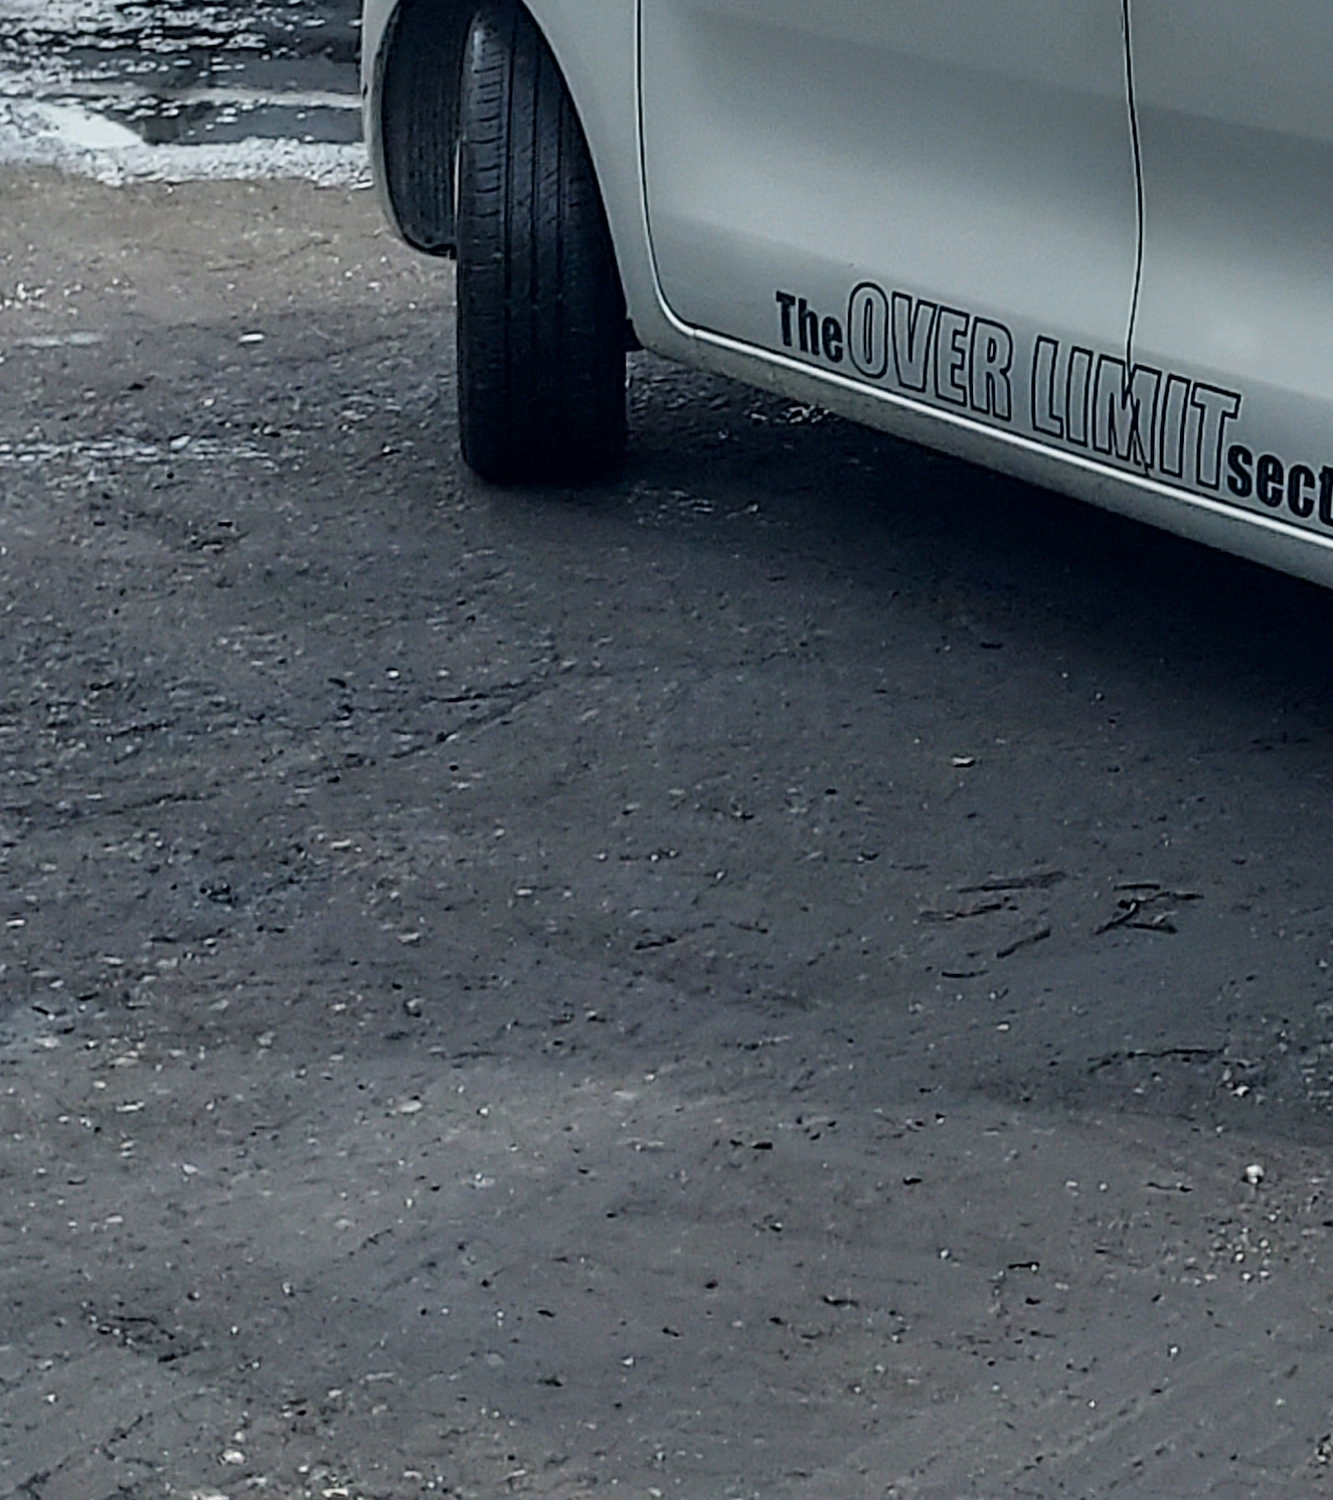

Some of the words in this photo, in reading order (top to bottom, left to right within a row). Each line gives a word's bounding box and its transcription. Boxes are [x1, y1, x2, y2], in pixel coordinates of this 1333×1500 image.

[776, 291, 844, 362] The
[848, 282, 1012, 421] OVER
[1031, 336, 1241, 489] LIMIT
